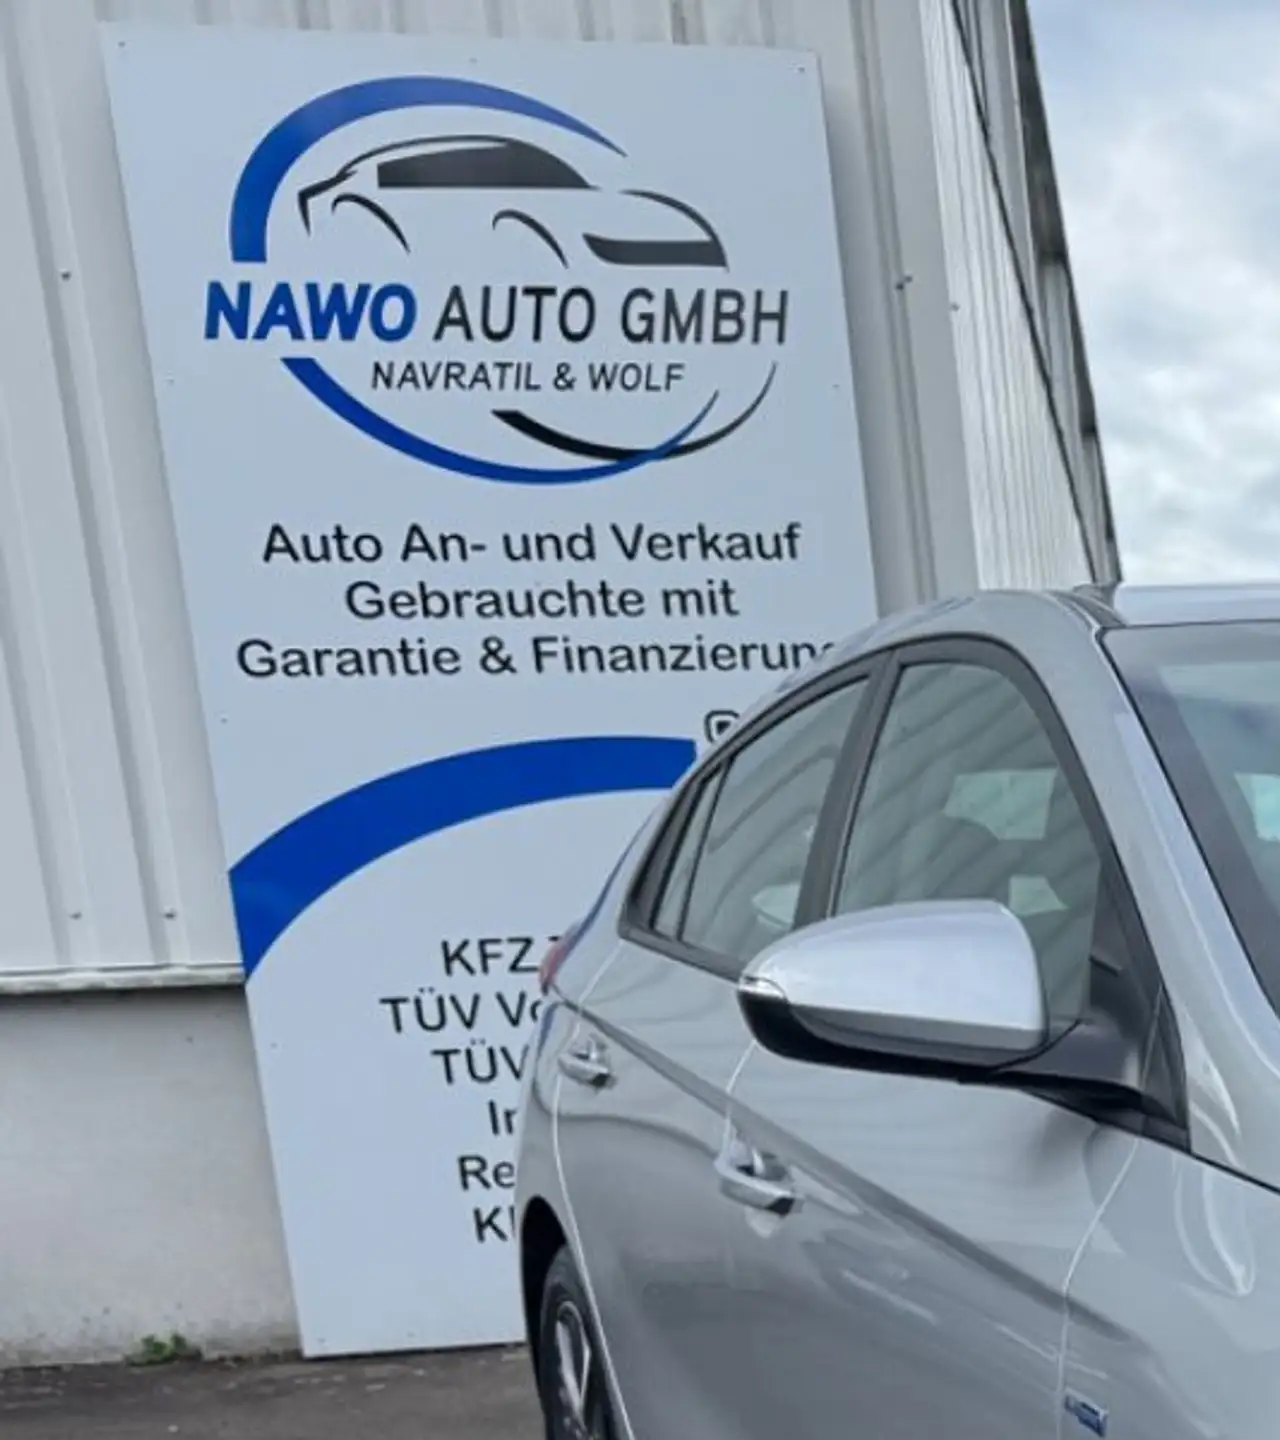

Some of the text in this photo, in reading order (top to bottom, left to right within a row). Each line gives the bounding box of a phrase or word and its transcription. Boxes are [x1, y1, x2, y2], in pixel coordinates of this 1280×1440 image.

[203, 279, 789, 346] NAWO AUTO GMBH
[371, 360, 685, 393] NAVRATIL & WOLF
[262, 521, 802, 564] Auto An- und Verkauf
[344, 578, 741, 621] Gebrauchte mit
[236, 636, 462, 679] Garantie
[478, 635, 518, 676] &
[440, 935, 541, 978] KFZ
[378, 986, 482, 1035] TÜV
[430, 1038, 530, 1086] TÜV
